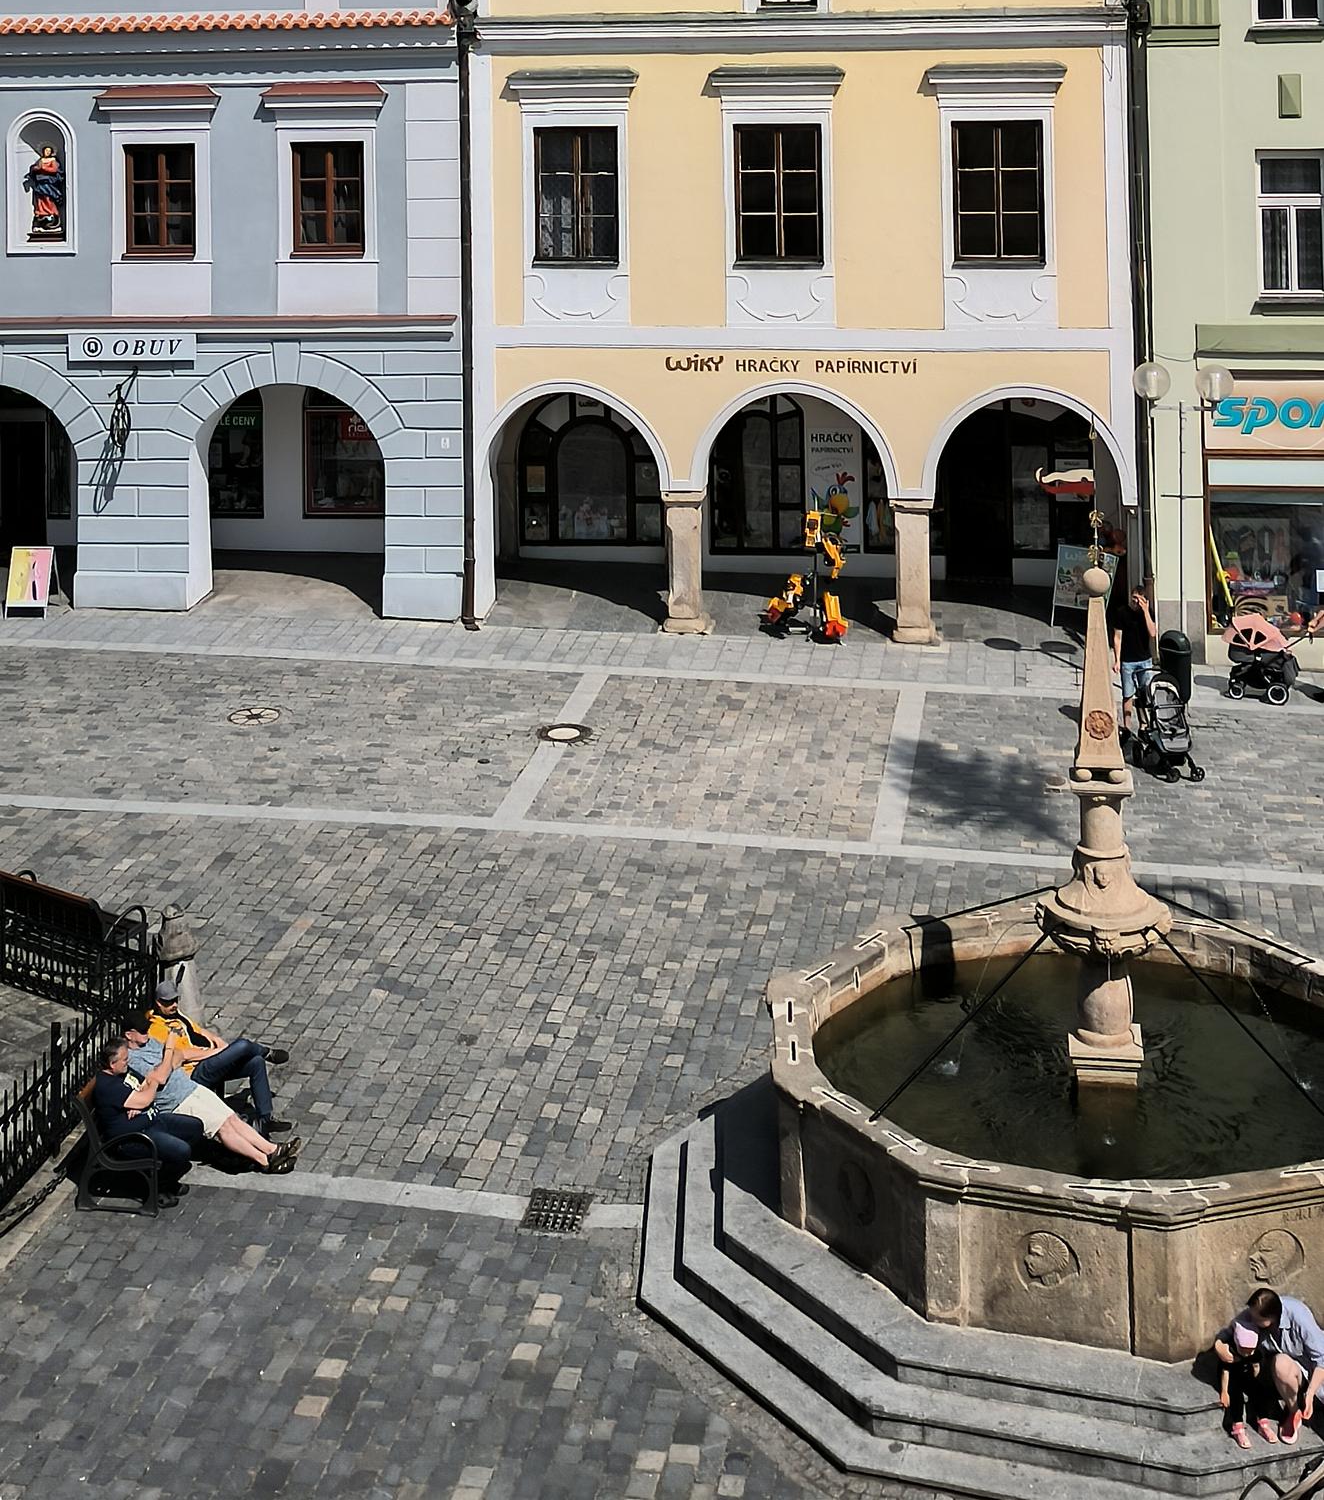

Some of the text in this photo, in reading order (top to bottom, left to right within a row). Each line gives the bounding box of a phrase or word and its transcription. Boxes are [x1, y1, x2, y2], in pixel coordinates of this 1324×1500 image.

[112, 339, 182, 356] OBUV
[735, 356, 800, 373] HRAČKY
[815, 357, 918, 374] PAPÍRNICTVÍ
[232, 416, 256, 426] CENY
